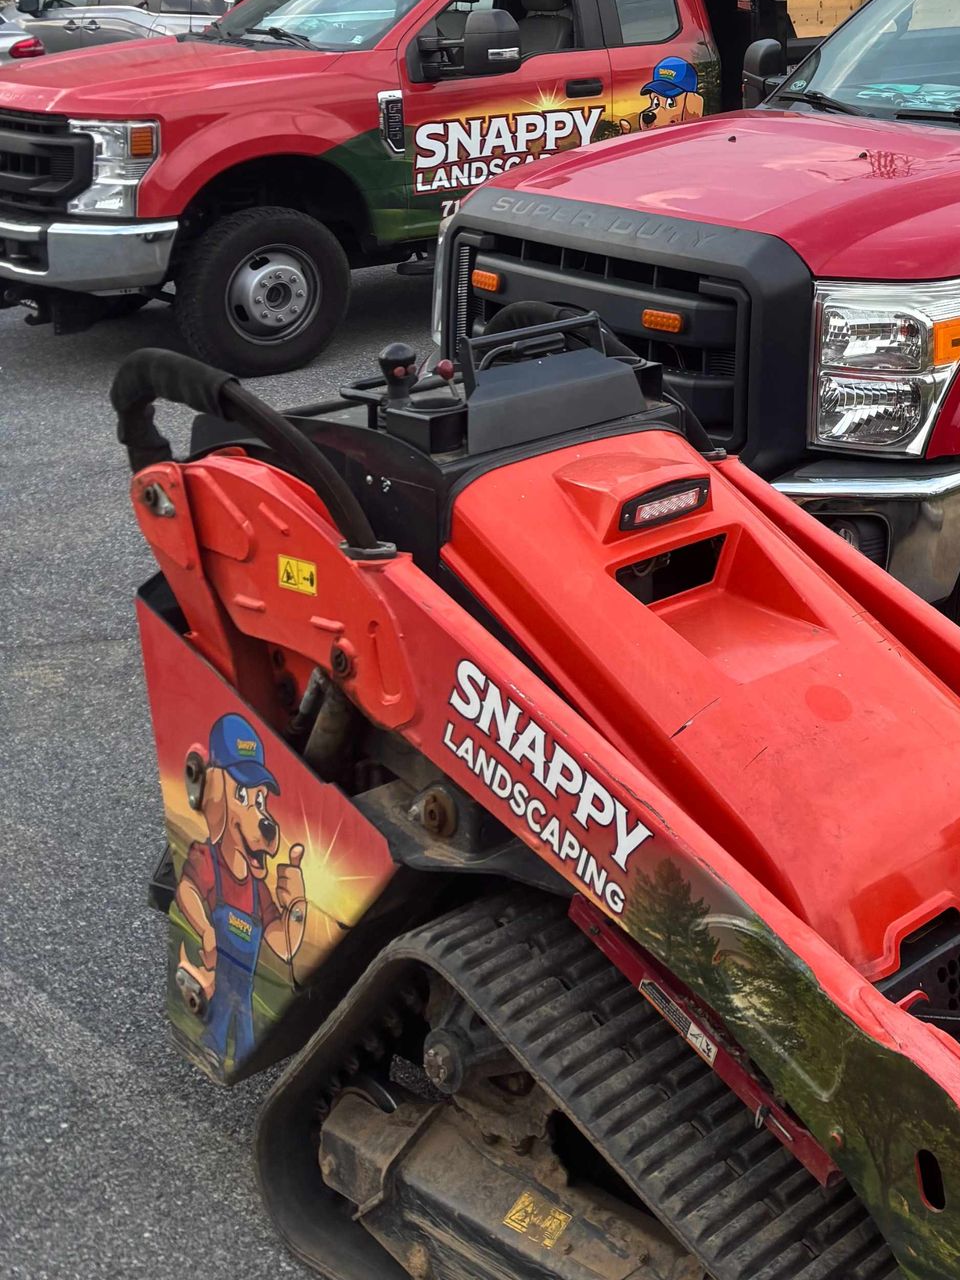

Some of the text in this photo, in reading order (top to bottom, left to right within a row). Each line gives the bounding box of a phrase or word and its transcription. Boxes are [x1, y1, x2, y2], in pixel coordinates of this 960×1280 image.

[414, 107, 604, 170] SNAPPY
[442, 721, 626, 915] LANDSCAPING
[449, 659, 654, 872] SNAPPY
